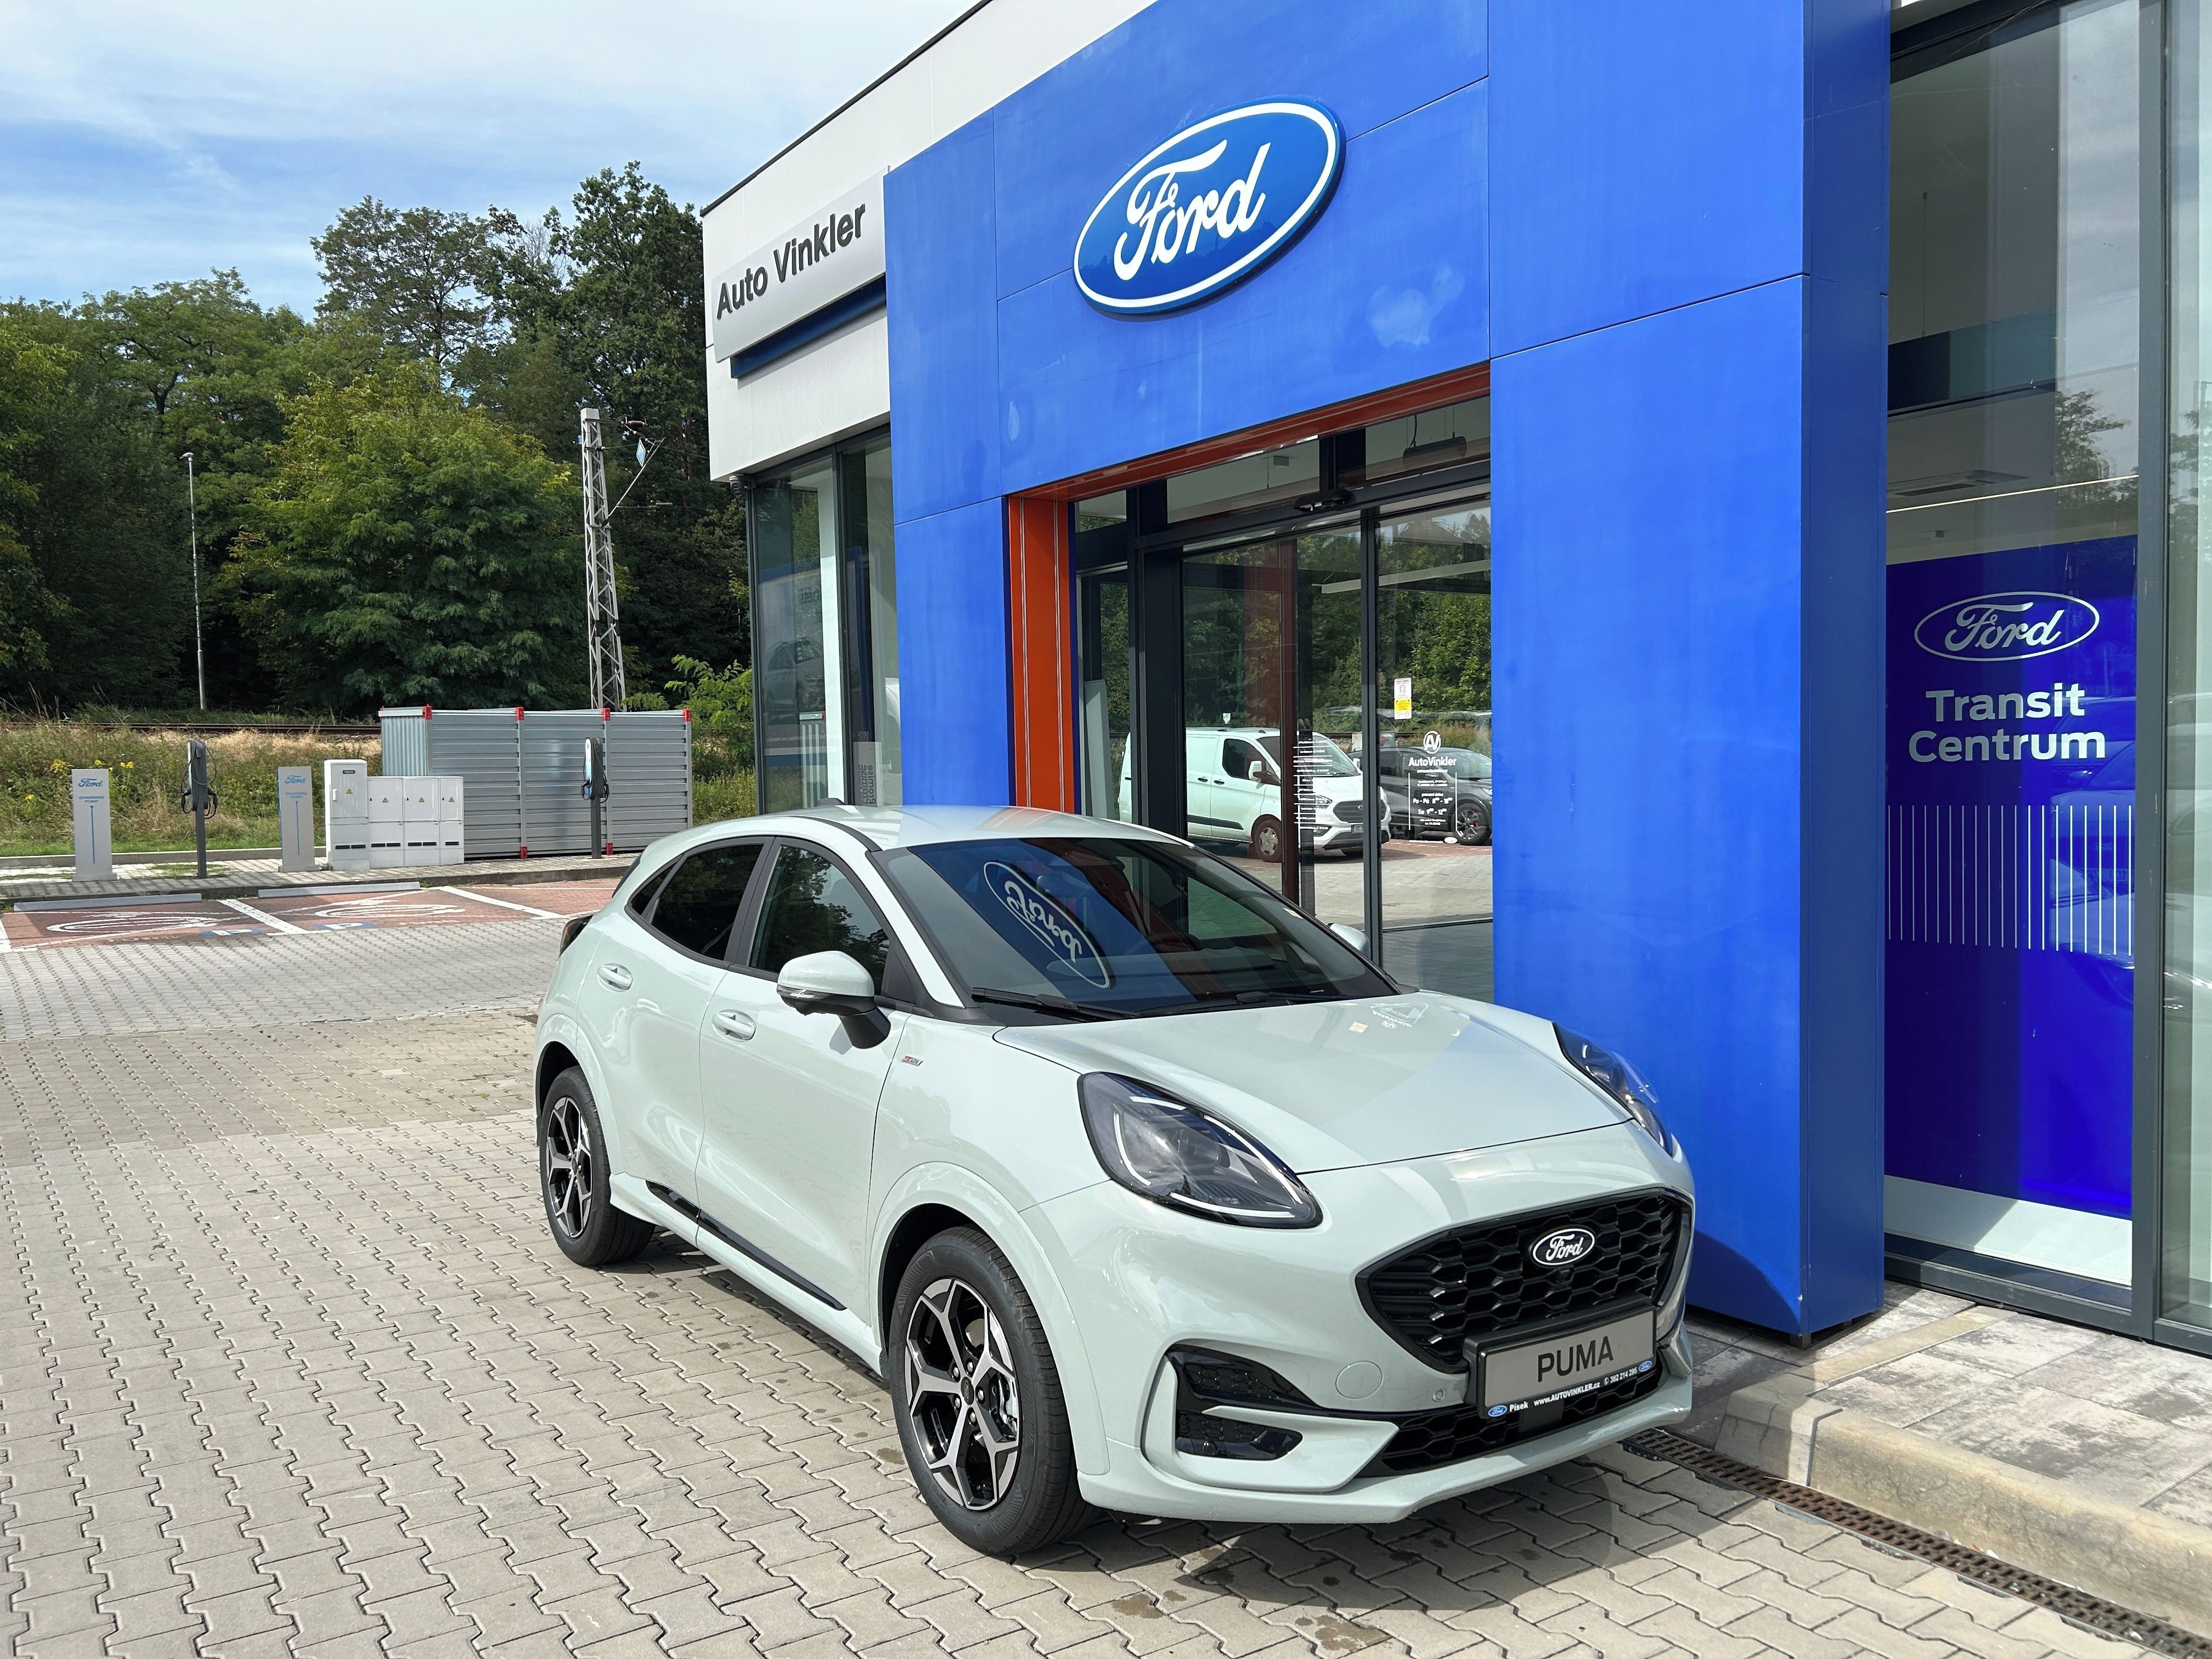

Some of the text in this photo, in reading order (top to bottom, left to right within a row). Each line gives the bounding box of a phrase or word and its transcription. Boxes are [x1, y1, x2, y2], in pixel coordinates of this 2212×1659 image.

[1113, 139, 1271, 281] Ford
[716, 202, 866, 320] Auto Vinkler
[1944, 601, 2065, 652] Ford
[1926, 682, 2085, 722] Transit
[1408, 756, 1457, 767] AutoVinkler
[1909, 728, 2106, 763] Centrum
[78, 778, 103, 787] Ford
[285, 775, 307, 783] Ford
[1545, 1233, 1584, 1261] Ford
[1538, 1336, 1613, 1383] PUMA
